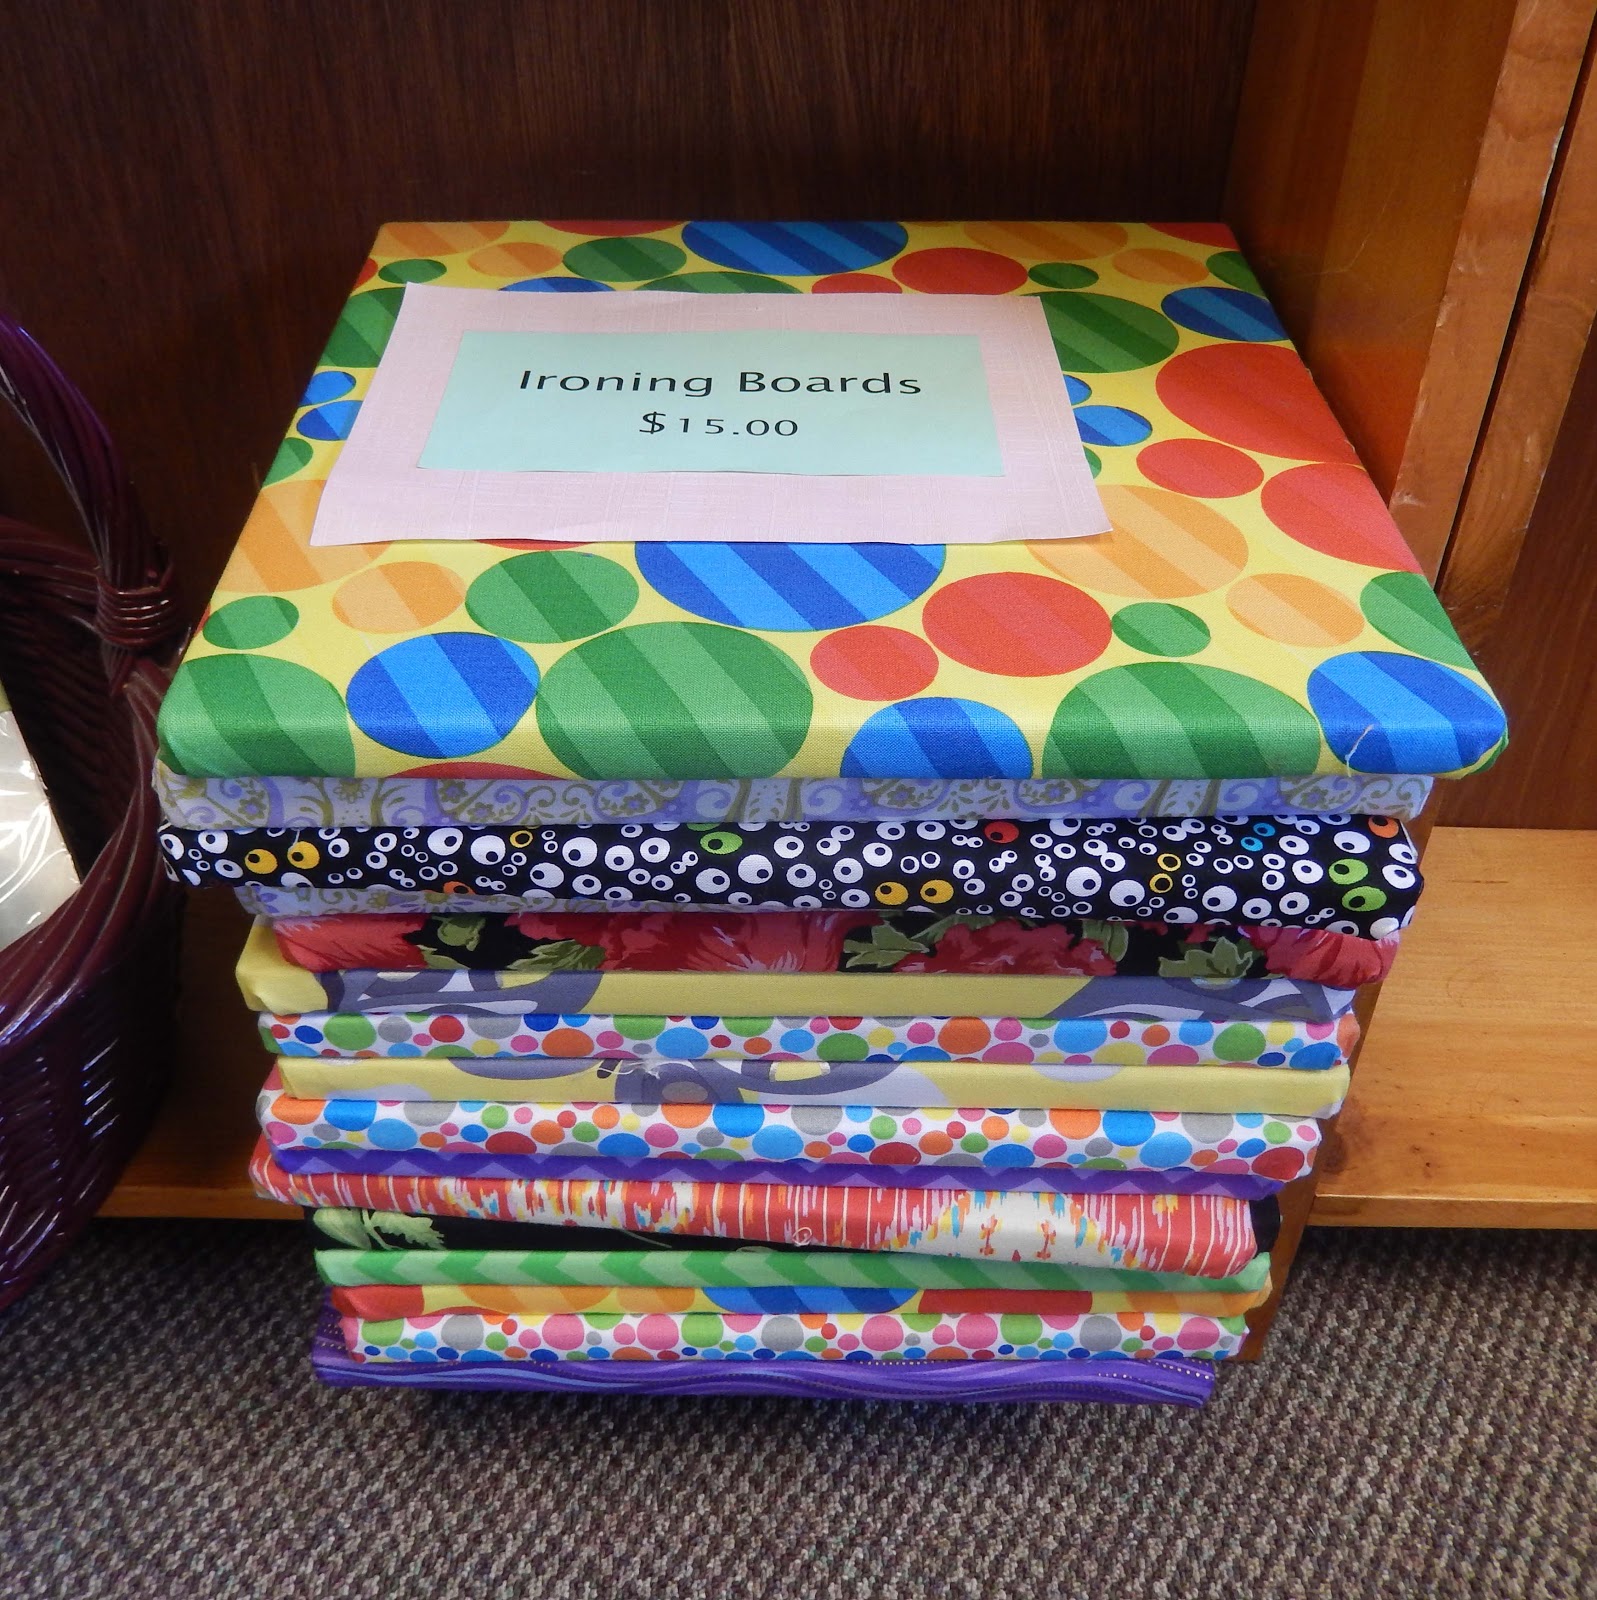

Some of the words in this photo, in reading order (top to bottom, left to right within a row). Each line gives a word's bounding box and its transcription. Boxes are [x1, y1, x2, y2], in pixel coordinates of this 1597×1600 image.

[519, 368, 714, 399] Ironing
[738, 370, 923, 396] Boards
[638, 410, 800, 437] $15.00
